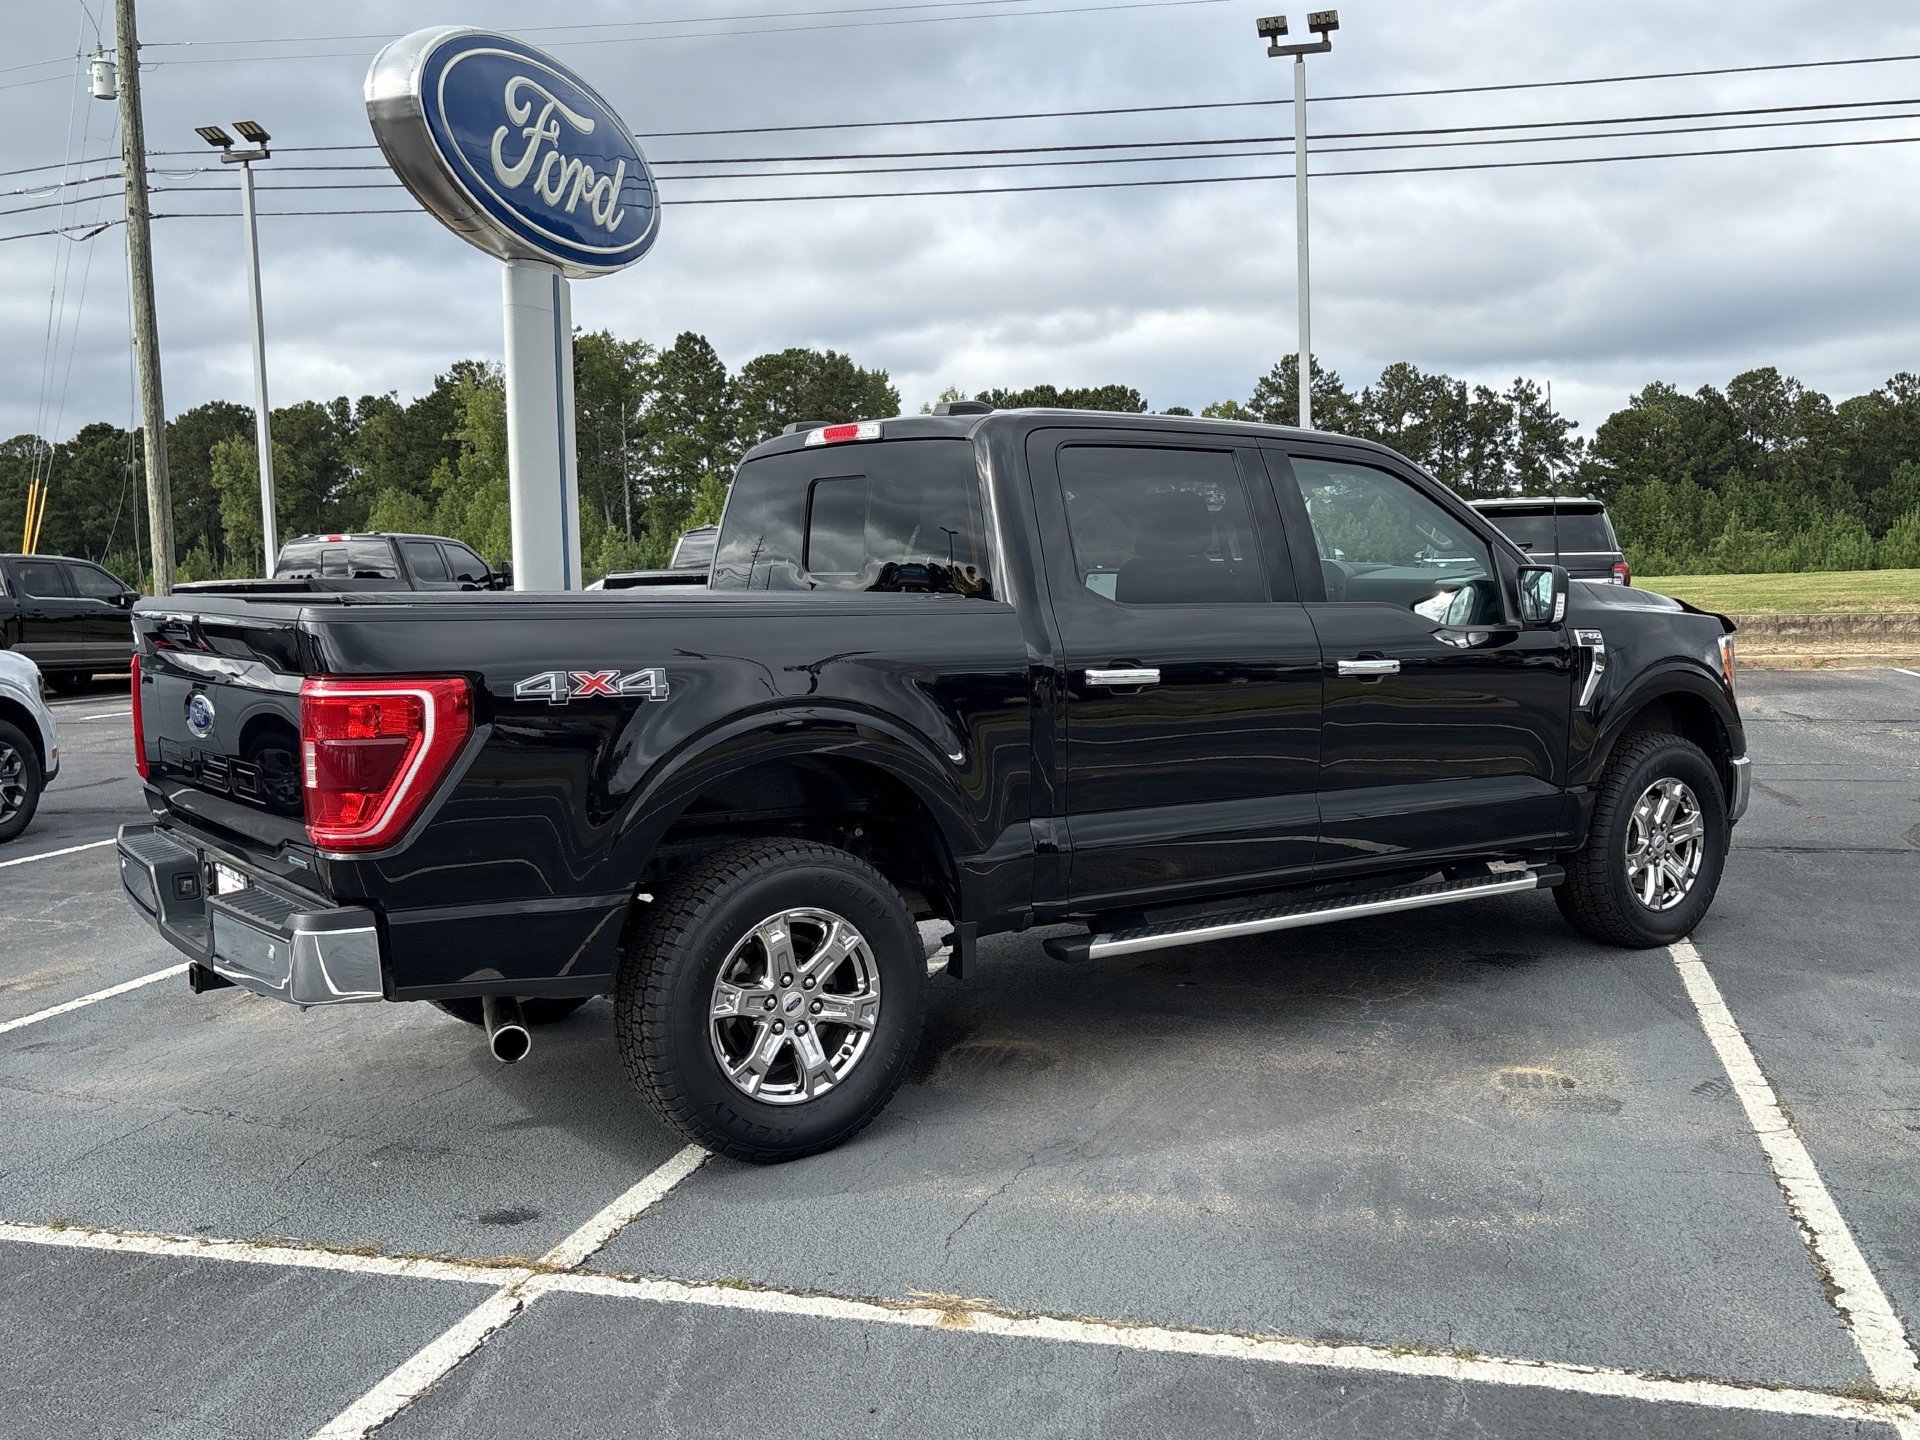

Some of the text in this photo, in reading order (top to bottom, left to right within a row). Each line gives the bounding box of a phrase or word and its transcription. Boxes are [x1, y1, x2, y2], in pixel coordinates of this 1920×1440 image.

[490, 75, 626, 233] Ford
[813, 874, 893, 919] KELLY
[703, 1102, 795, 1143] KELLY
